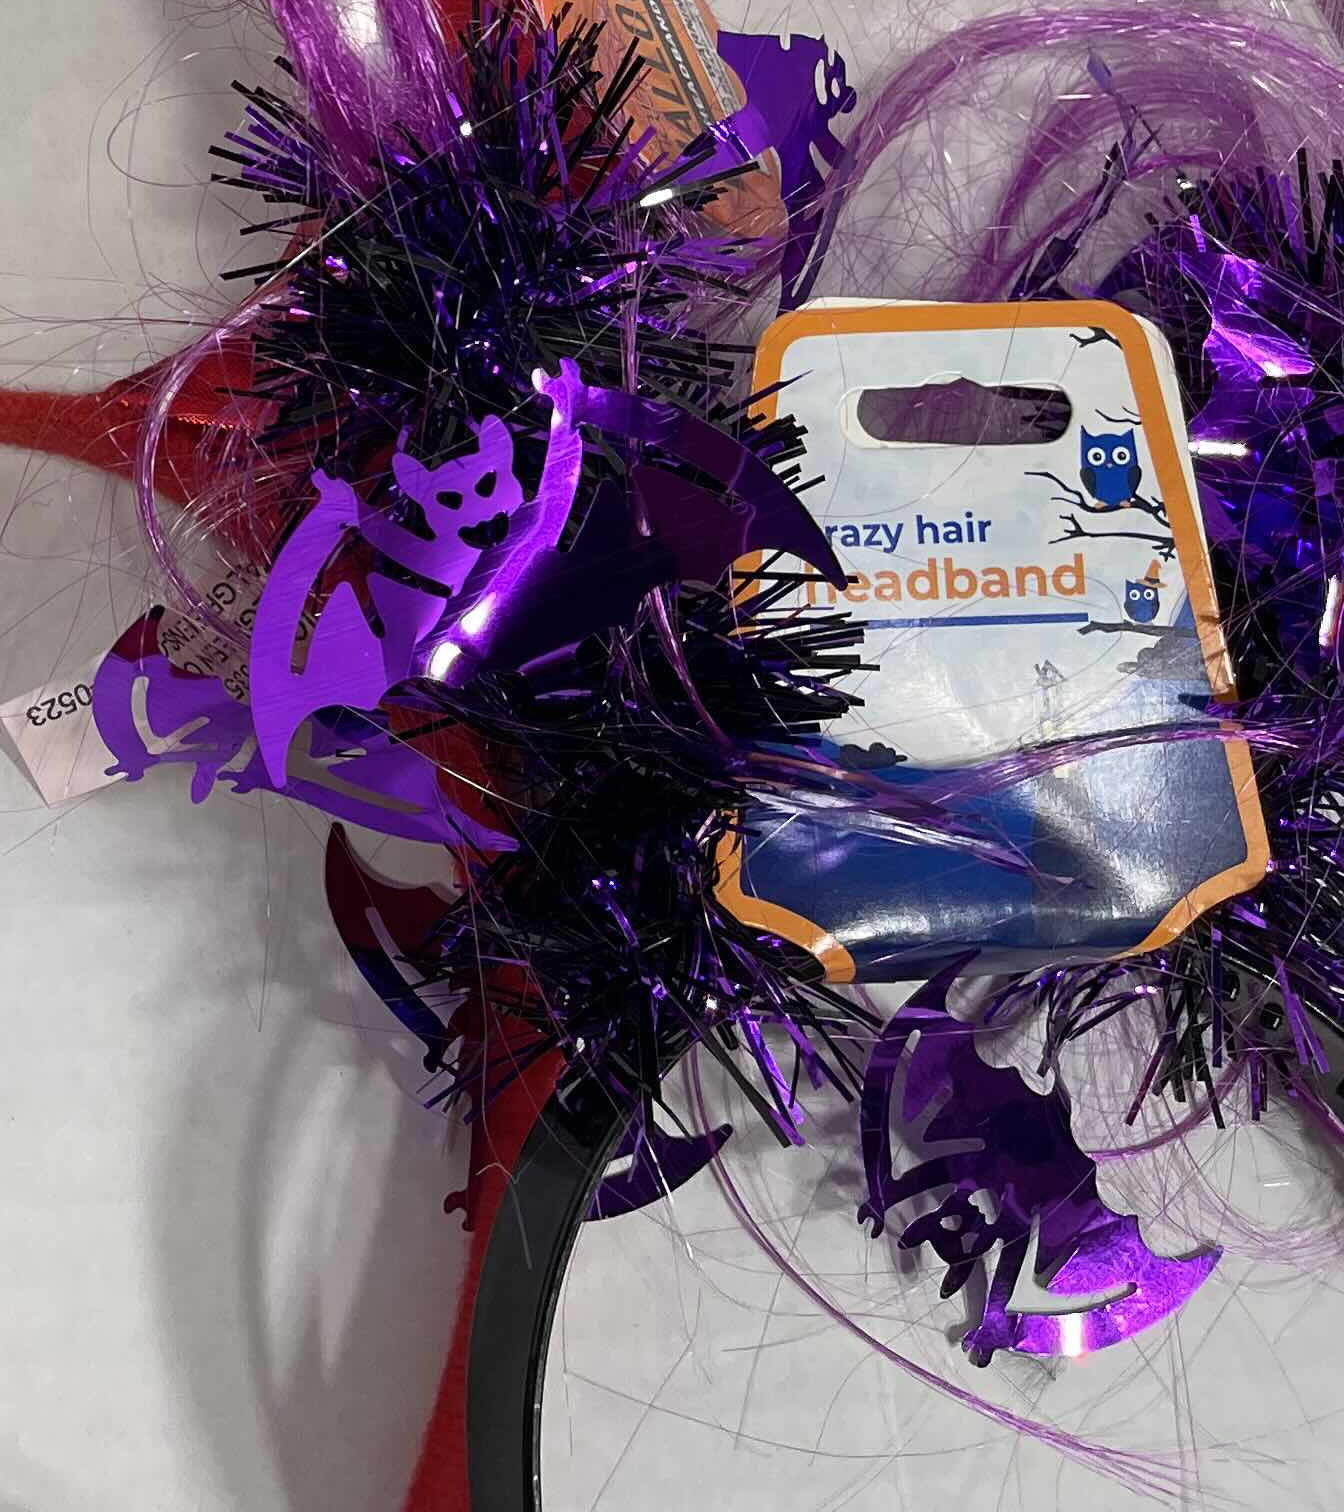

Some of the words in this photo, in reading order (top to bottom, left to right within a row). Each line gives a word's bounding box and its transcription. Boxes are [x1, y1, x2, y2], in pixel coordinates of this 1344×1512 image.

[824, 522, 904, 553] razy
[917, 511, 992, 544] hair
[804, 553, 1087, 606] headband
